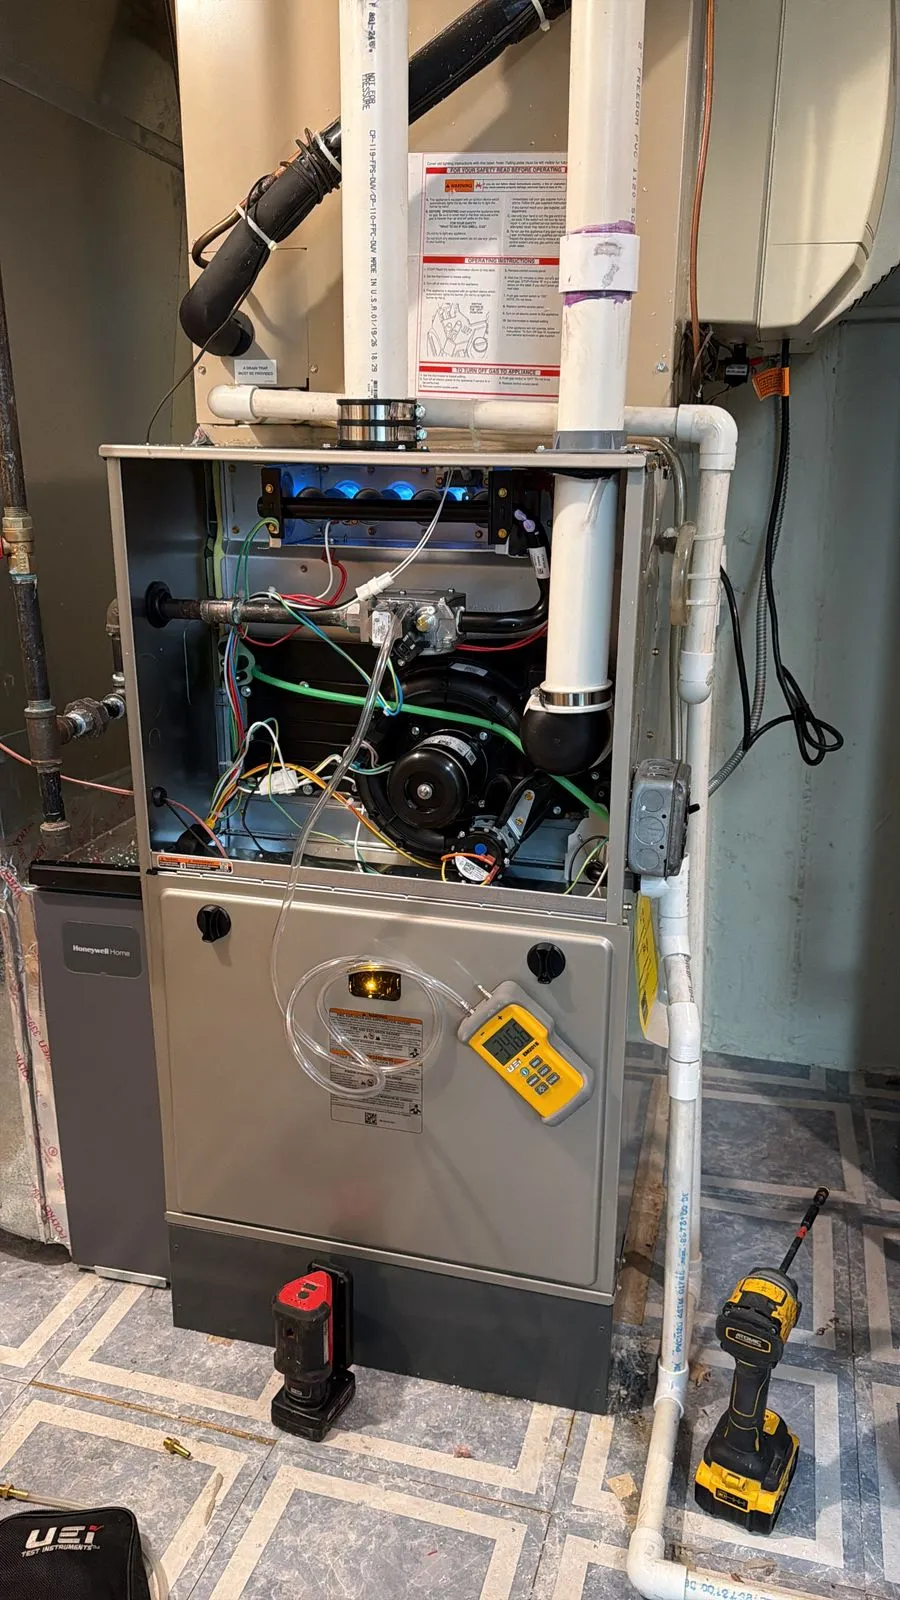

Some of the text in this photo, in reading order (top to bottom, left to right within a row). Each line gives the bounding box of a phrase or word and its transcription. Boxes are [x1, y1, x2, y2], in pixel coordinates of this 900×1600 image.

[362, 73, 371, 111] PRESSURE
[634, 67, 642, 127] FREEDOM
[630, 168, 638, 198] 1120
[370, 278, 377, 286] IN
[73, 945, 131, 957] Honeywell Home
[21, 1550, 42, 1558] TEST
